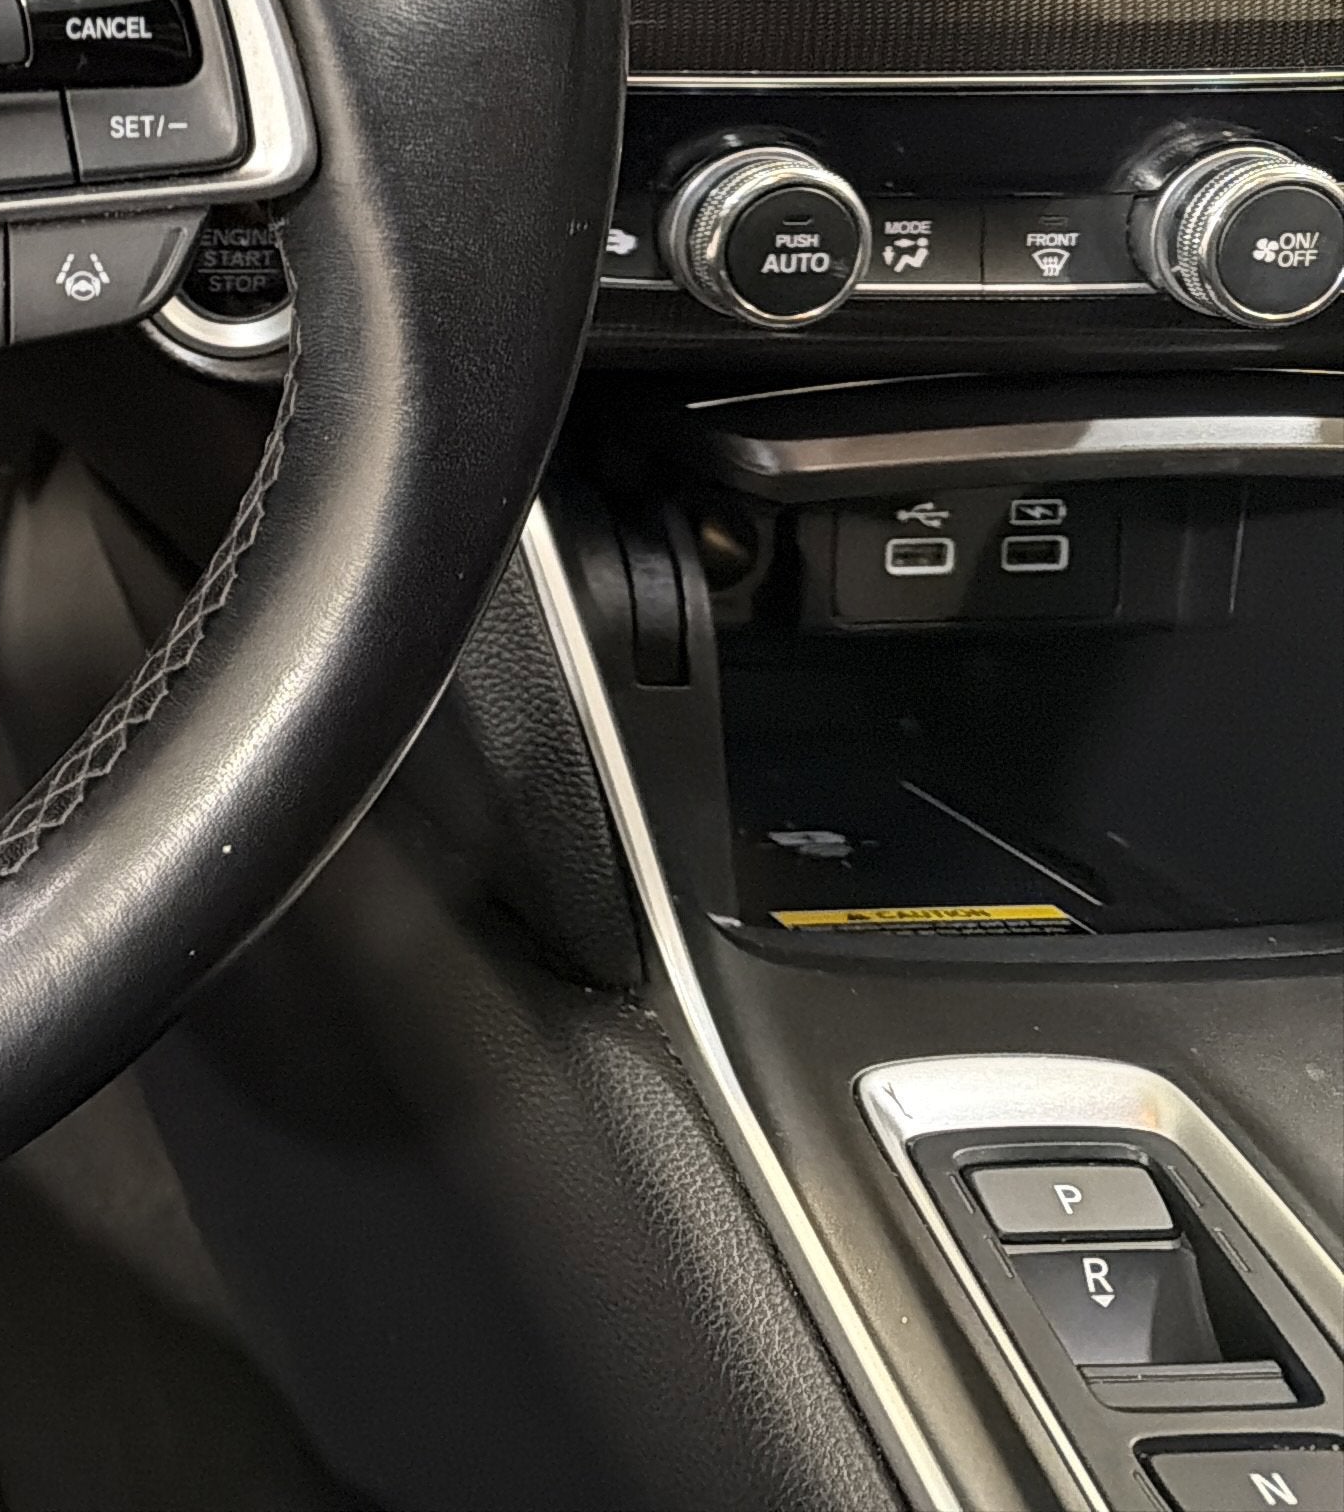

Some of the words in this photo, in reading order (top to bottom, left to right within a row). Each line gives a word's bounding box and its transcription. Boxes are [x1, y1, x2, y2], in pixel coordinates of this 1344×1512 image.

[65, 17, 153, 41] CANCEL
[884, 220, 932, 235] MODE
[775, 233, 820, 248] PUSH
[1026, 232, 1079, 247] FRONT
[1279, 232, 1320, 250] ON/
[202, 249, 275, 267] START
[760, 252, 830, 274] AUTO
[1277, 249, 1319, 268] OFF
[208, 275, 268, 292] STOP
[1052, 1183, 1083, 1216] P
[1082, 1257, 1115, 1294] R
[1248, 1472, 1299, 1507] N
